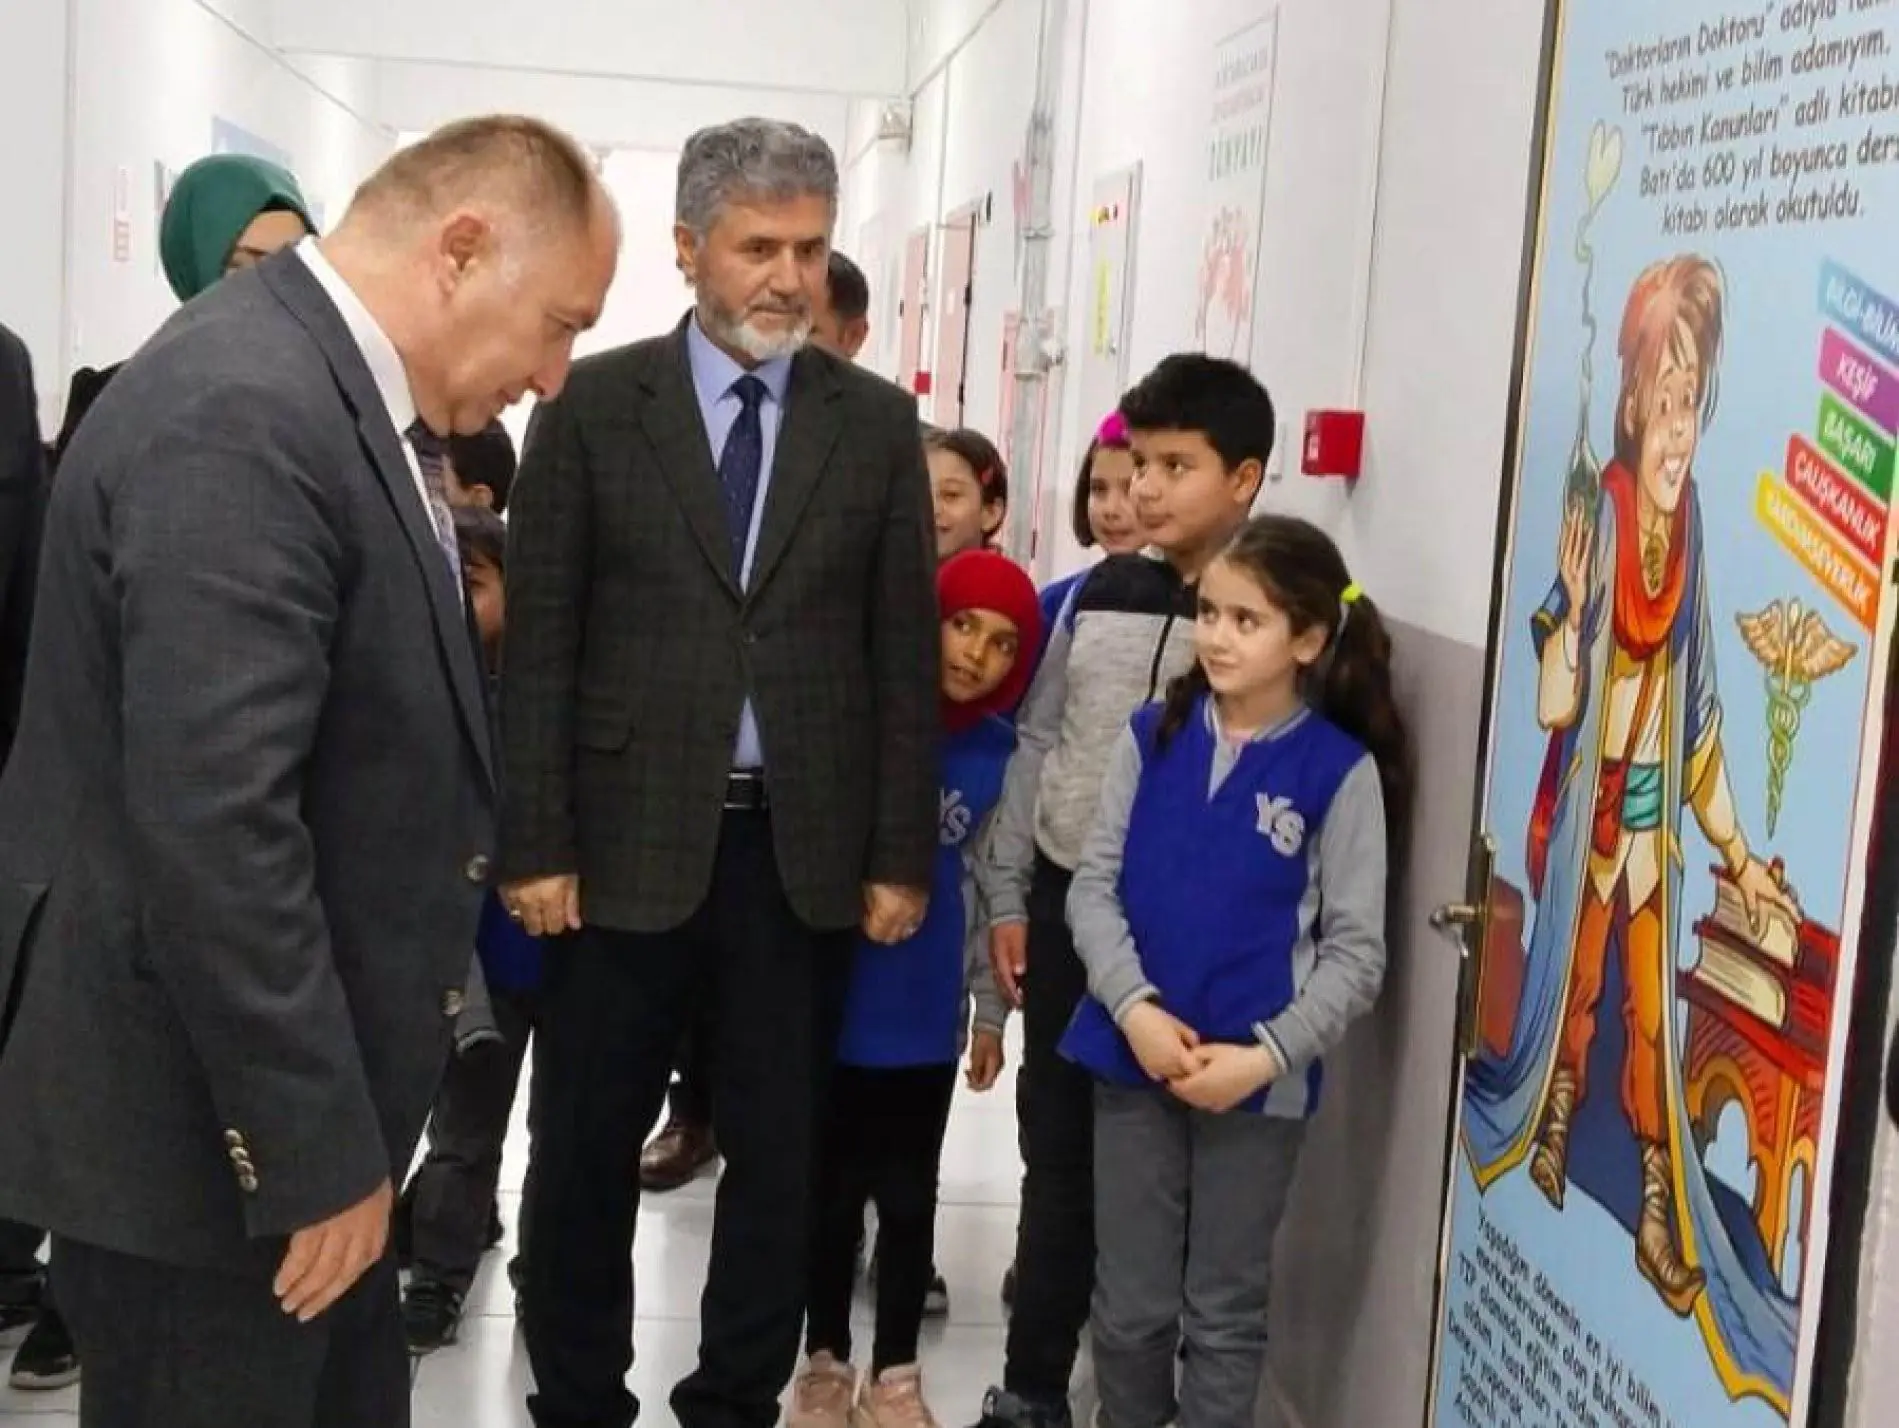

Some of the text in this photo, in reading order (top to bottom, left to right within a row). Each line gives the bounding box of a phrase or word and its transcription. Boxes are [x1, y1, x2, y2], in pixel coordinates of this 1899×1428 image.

[1622, 78, 1653, 113] Türk
[1660, 62, 1709, 104] hekimi
[1716, 66, 1733, 91] ve
[1742, 47, 1782, 86] bilim
[1795, 87, 1829, 125] adlı
[1703, 151, 1735, 188] 600
[1743, 146, 1764, 192] yıl
[1770, 142, 1847, 195] boyunca
[1662, 201, 1708, 236] kitabı
[1714, 188, 1768, 230] olarak
[939, 787, 972, 846] YS
[1255, 791, 1306, 858] YS
[1585, 1331, 1601, 1365] en
